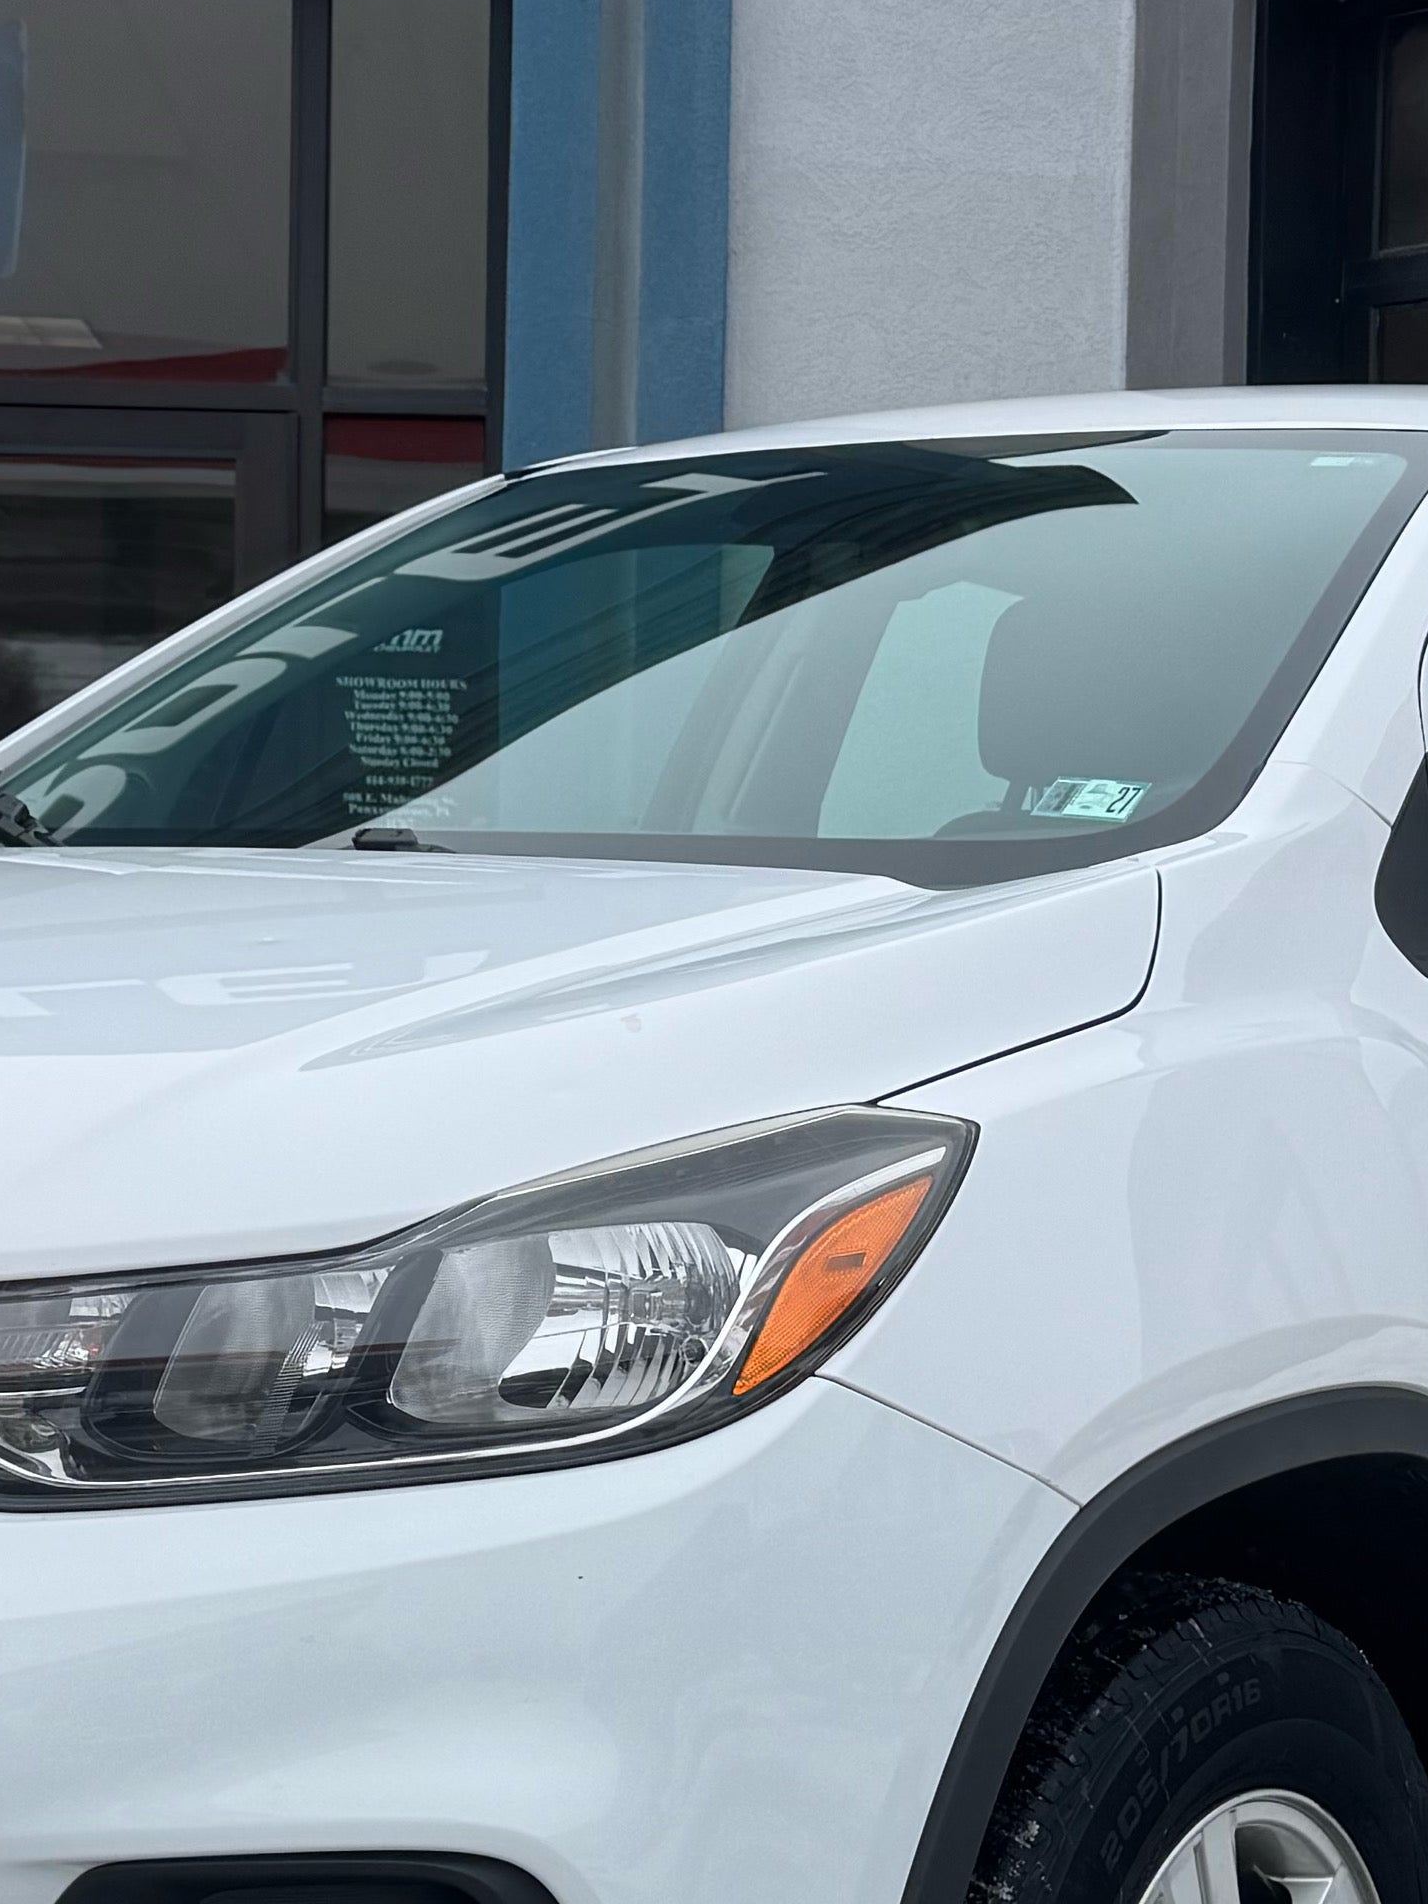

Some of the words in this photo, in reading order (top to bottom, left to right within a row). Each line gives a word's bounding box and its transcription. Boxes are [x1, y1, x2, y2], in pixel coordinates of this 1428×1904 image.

[336, 676, 419, 689] SHOWROOM
[420, 678, 468, 691] HOURS
[1106, 786, 1142, 814] 27
